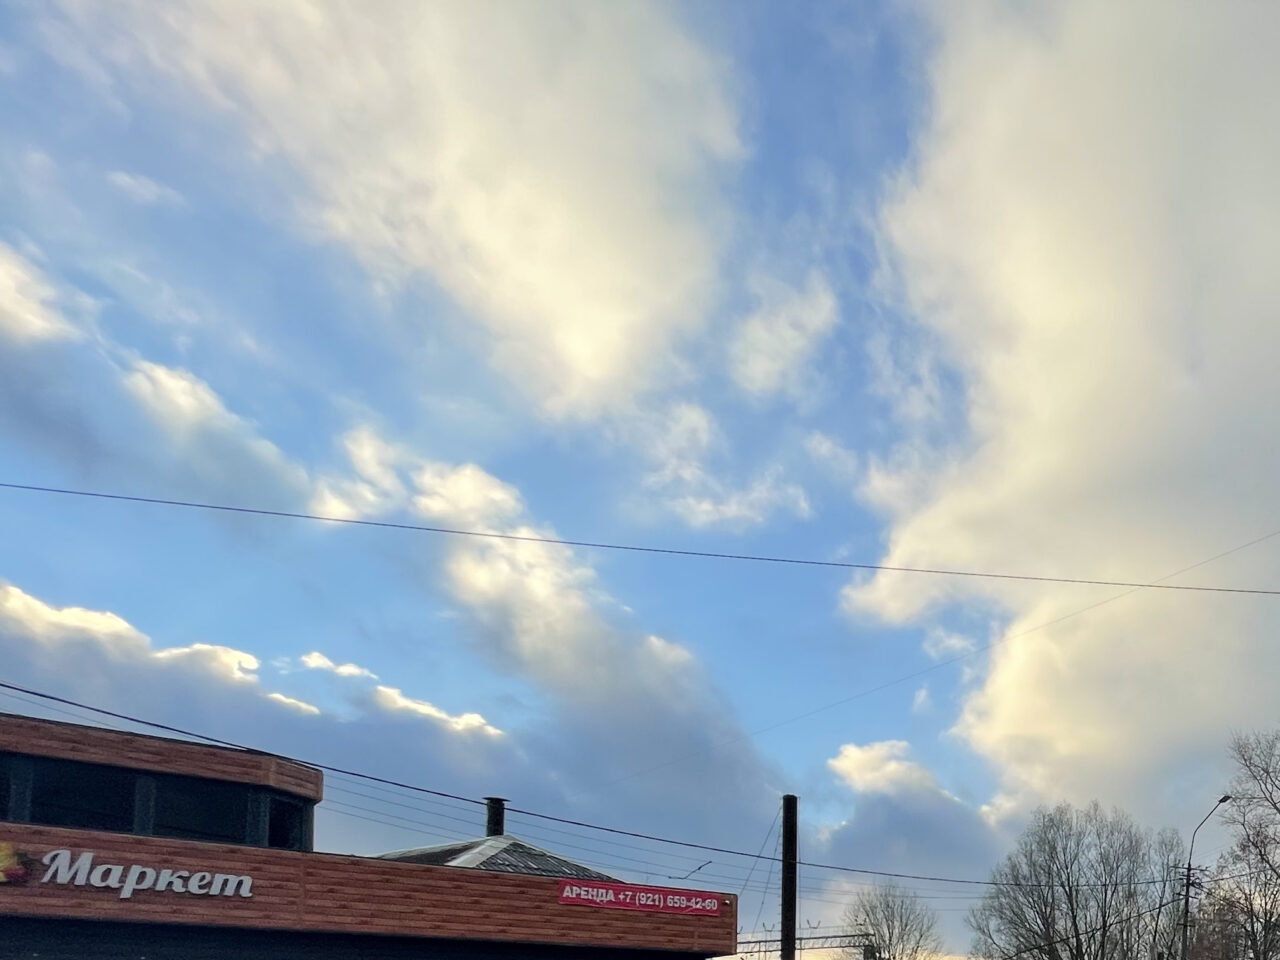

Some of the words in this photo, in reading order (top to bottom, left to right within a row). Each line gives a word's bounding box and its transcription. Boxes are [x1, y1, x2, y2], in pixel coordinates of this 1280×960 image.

[41, 849, 254, 899] Маркет
[562, 885, 615, 903] АРЕНДА
[618, 891, 633, 903] +7
[635, 892, 664, 908] (921)
[667, 895, 718, 910] 659-42-60
